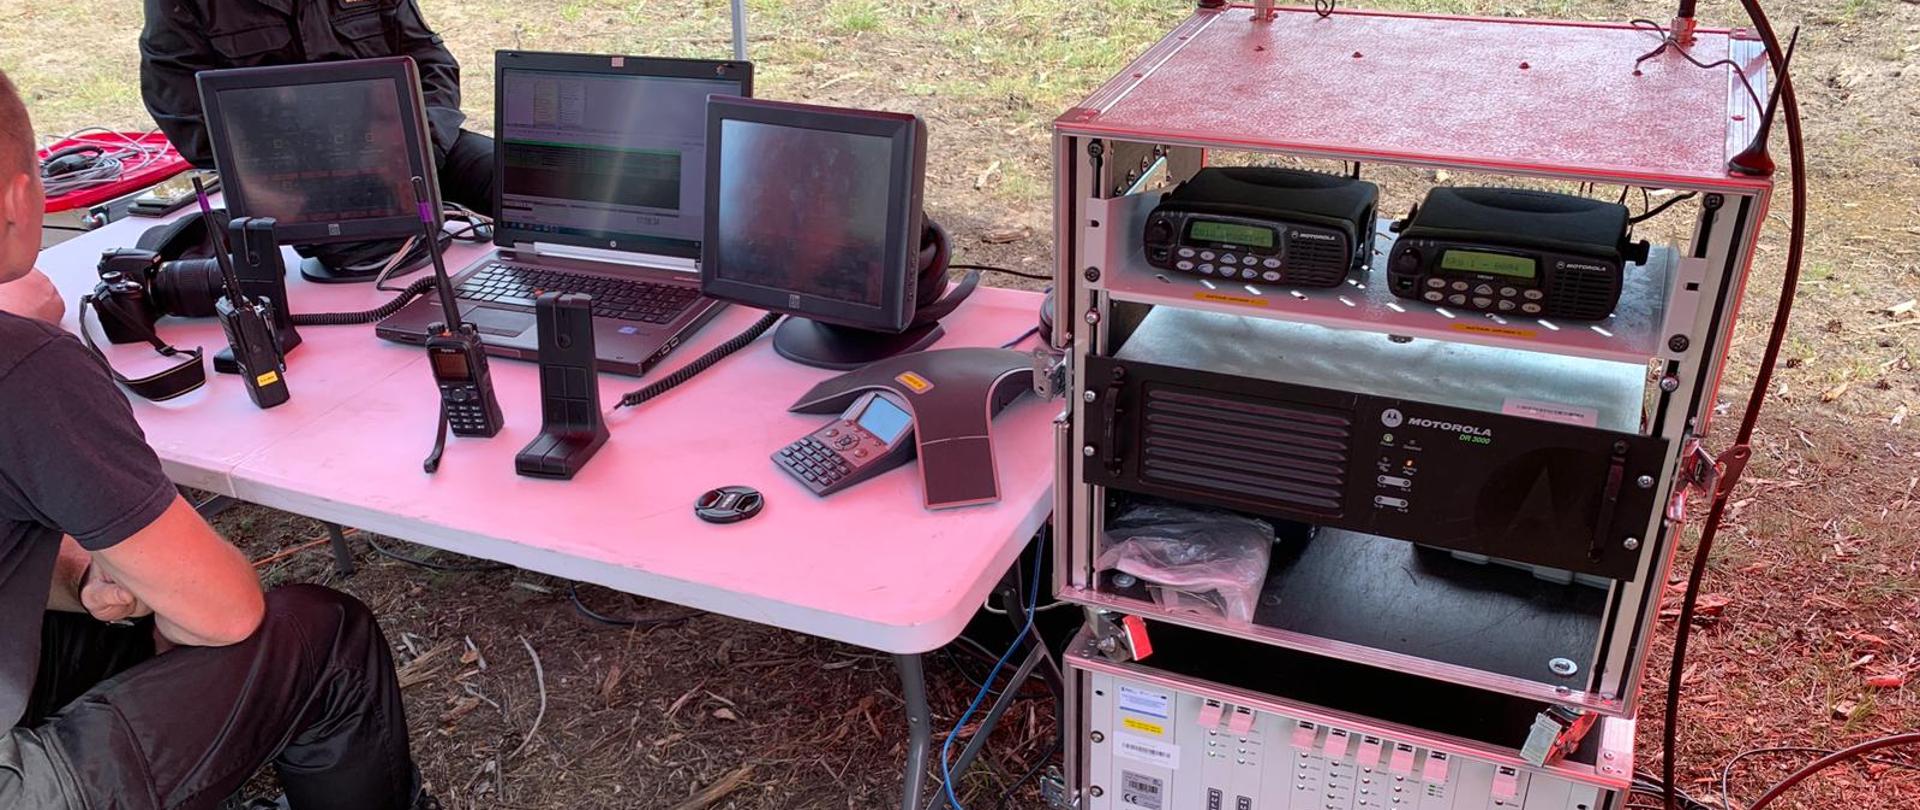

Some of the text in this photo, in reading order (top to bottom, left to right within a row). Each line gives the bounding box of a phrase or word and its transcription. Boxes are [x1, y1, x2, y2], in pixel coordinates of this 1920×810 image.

[1299, 233, 1335, 241] MOTOROLA
[1566, 263, 1606, 272] MOTOROLA
[1407, 417, 1492, 437] MOTOROLA
[1459, 434, 1492, 445] DR 3000
